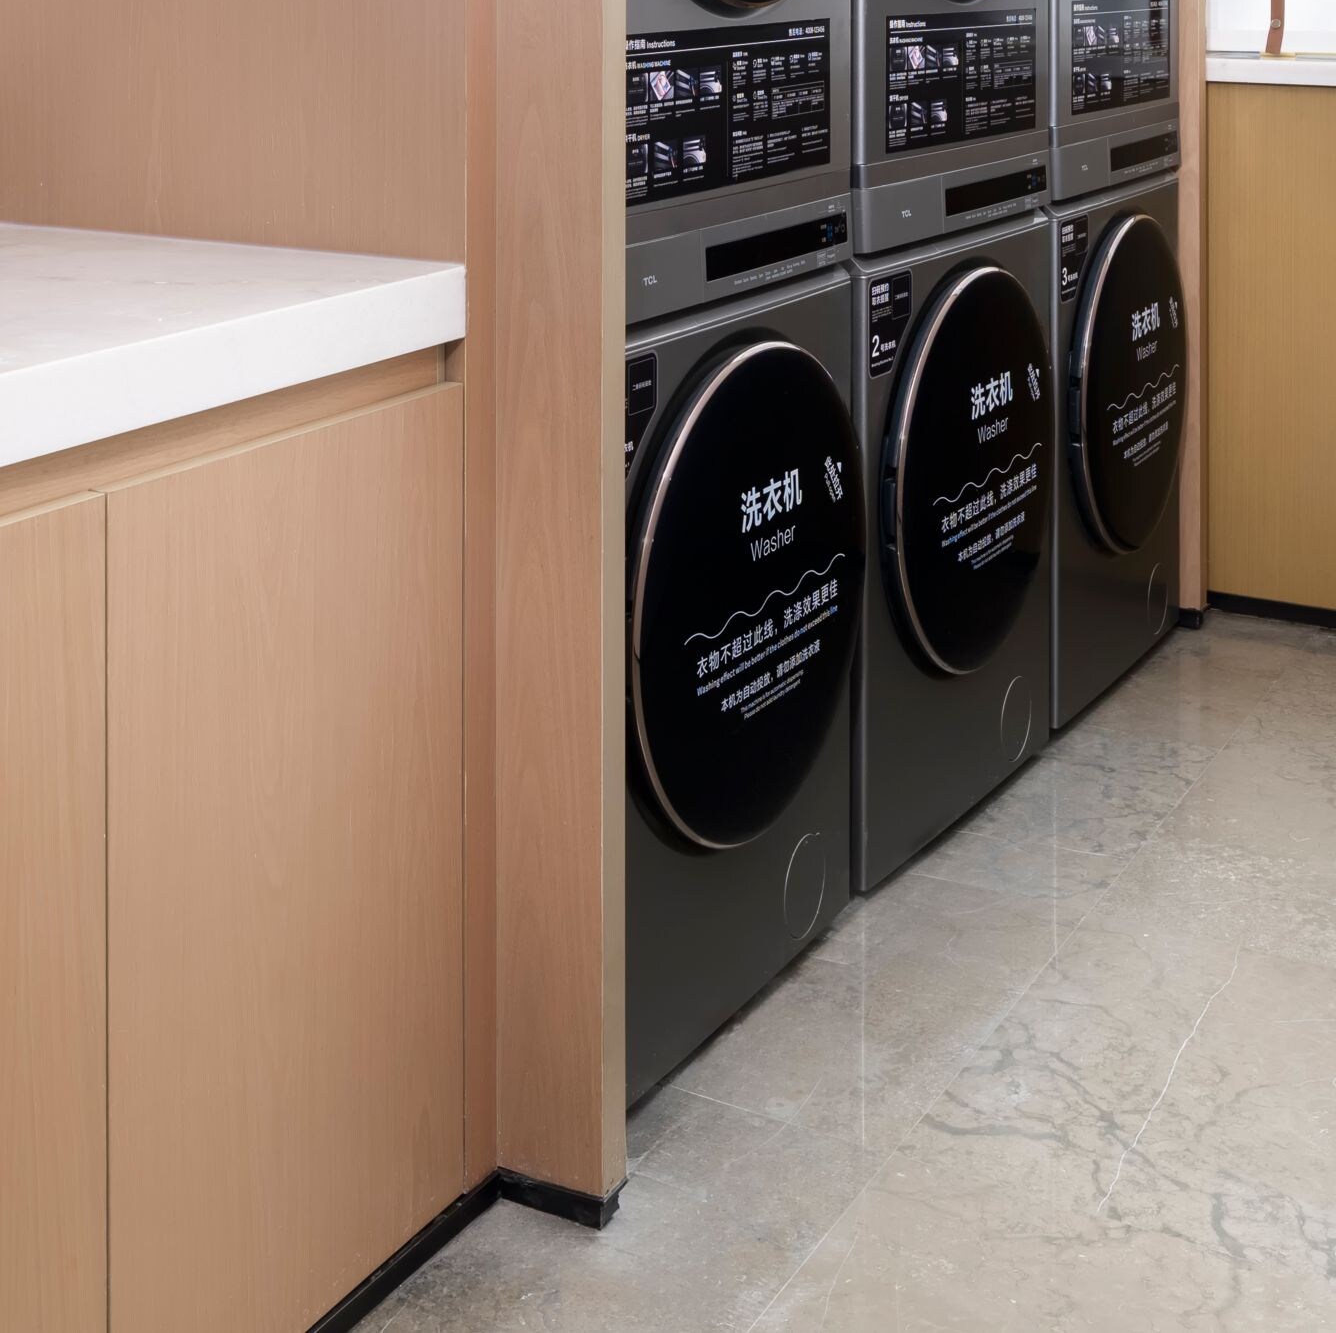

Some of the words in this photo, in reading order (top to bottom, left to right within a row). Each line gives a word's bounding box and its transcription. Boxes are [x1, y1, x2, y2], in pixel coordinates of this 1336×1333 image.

[906, 20, 926, 28] Instructions
[646, 40, 675, 49] Instructions
[902, 210, 912, 218] TCL
[642, 276, 658, 286] TCL
[1062, 267, 1068, 286] 3
[1132, 302, 1160, 342] 洗衣机
[872, 334, 880, 357] 2
[1136, 340, 1158, 362] Washer
[971, 370, 1014, 420] 洗衣机
[978, 417, 1008, 444] Washer
[740, 468, 802, 533] 洗衣机
[750, 524, 796, 562] Washer
[696, 579, 838, 678] 衣物不超过此线，洗涤效果更佳
[696, 677, 720, 697] Washing
[720, 669, 736, 684] effect
[736, 663, 744, 674] will
[744, 659, 750, 670] be
[751, 652, 766, 666] better
[777, 635, 794, 650] clothes
[799, 626, 808, 636] not
[808, 618, 821, 630] exceed
[821, 612, 830, 622] this
[830, 604, 838, 615] line
